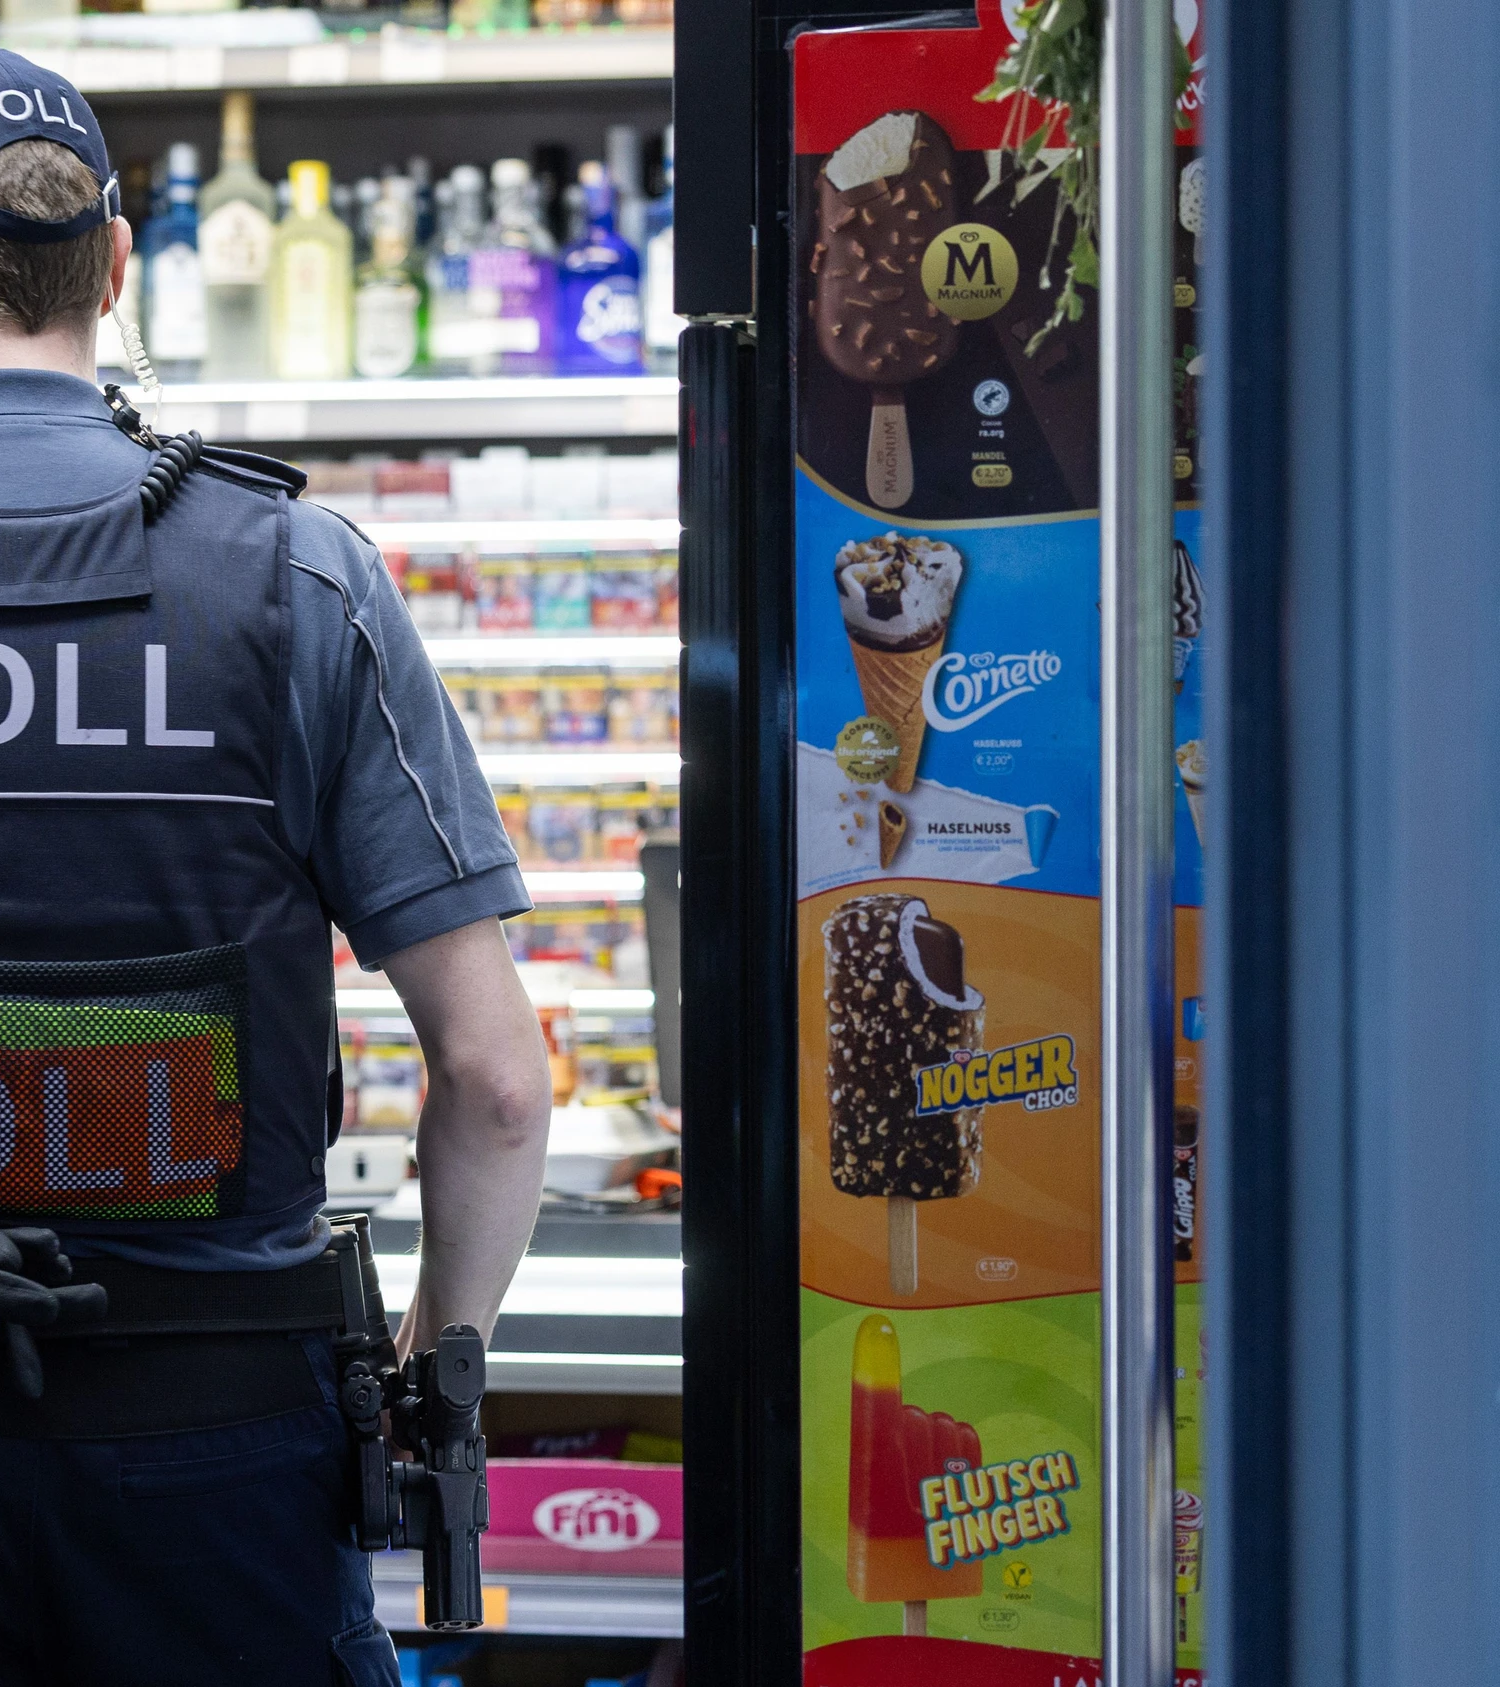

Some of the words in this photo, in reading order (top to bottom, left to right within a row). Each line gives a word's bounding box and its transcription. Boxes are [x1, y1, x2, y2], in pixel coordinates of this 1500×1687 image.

[943, 240, 996, 286] M
[937, 288, 1003, 300] MAGNUM
[883, 419, 897, 493] MAGNUM
[971, 451, 1006, 461] MANDEL
[921, 650, 1062, 732] Cornetto
[927, 823, 1011, 834] HASELNUSS
[921, 1036, 1076, 1110] NOGGER
[1025, 1086, 1076, 1110] CHOC
[922, 1452, 1076, 1520] FLUTSCH
[553, 1494, 638, 1538] Fini
[928, 1495, 1067, 1566] FINGER
